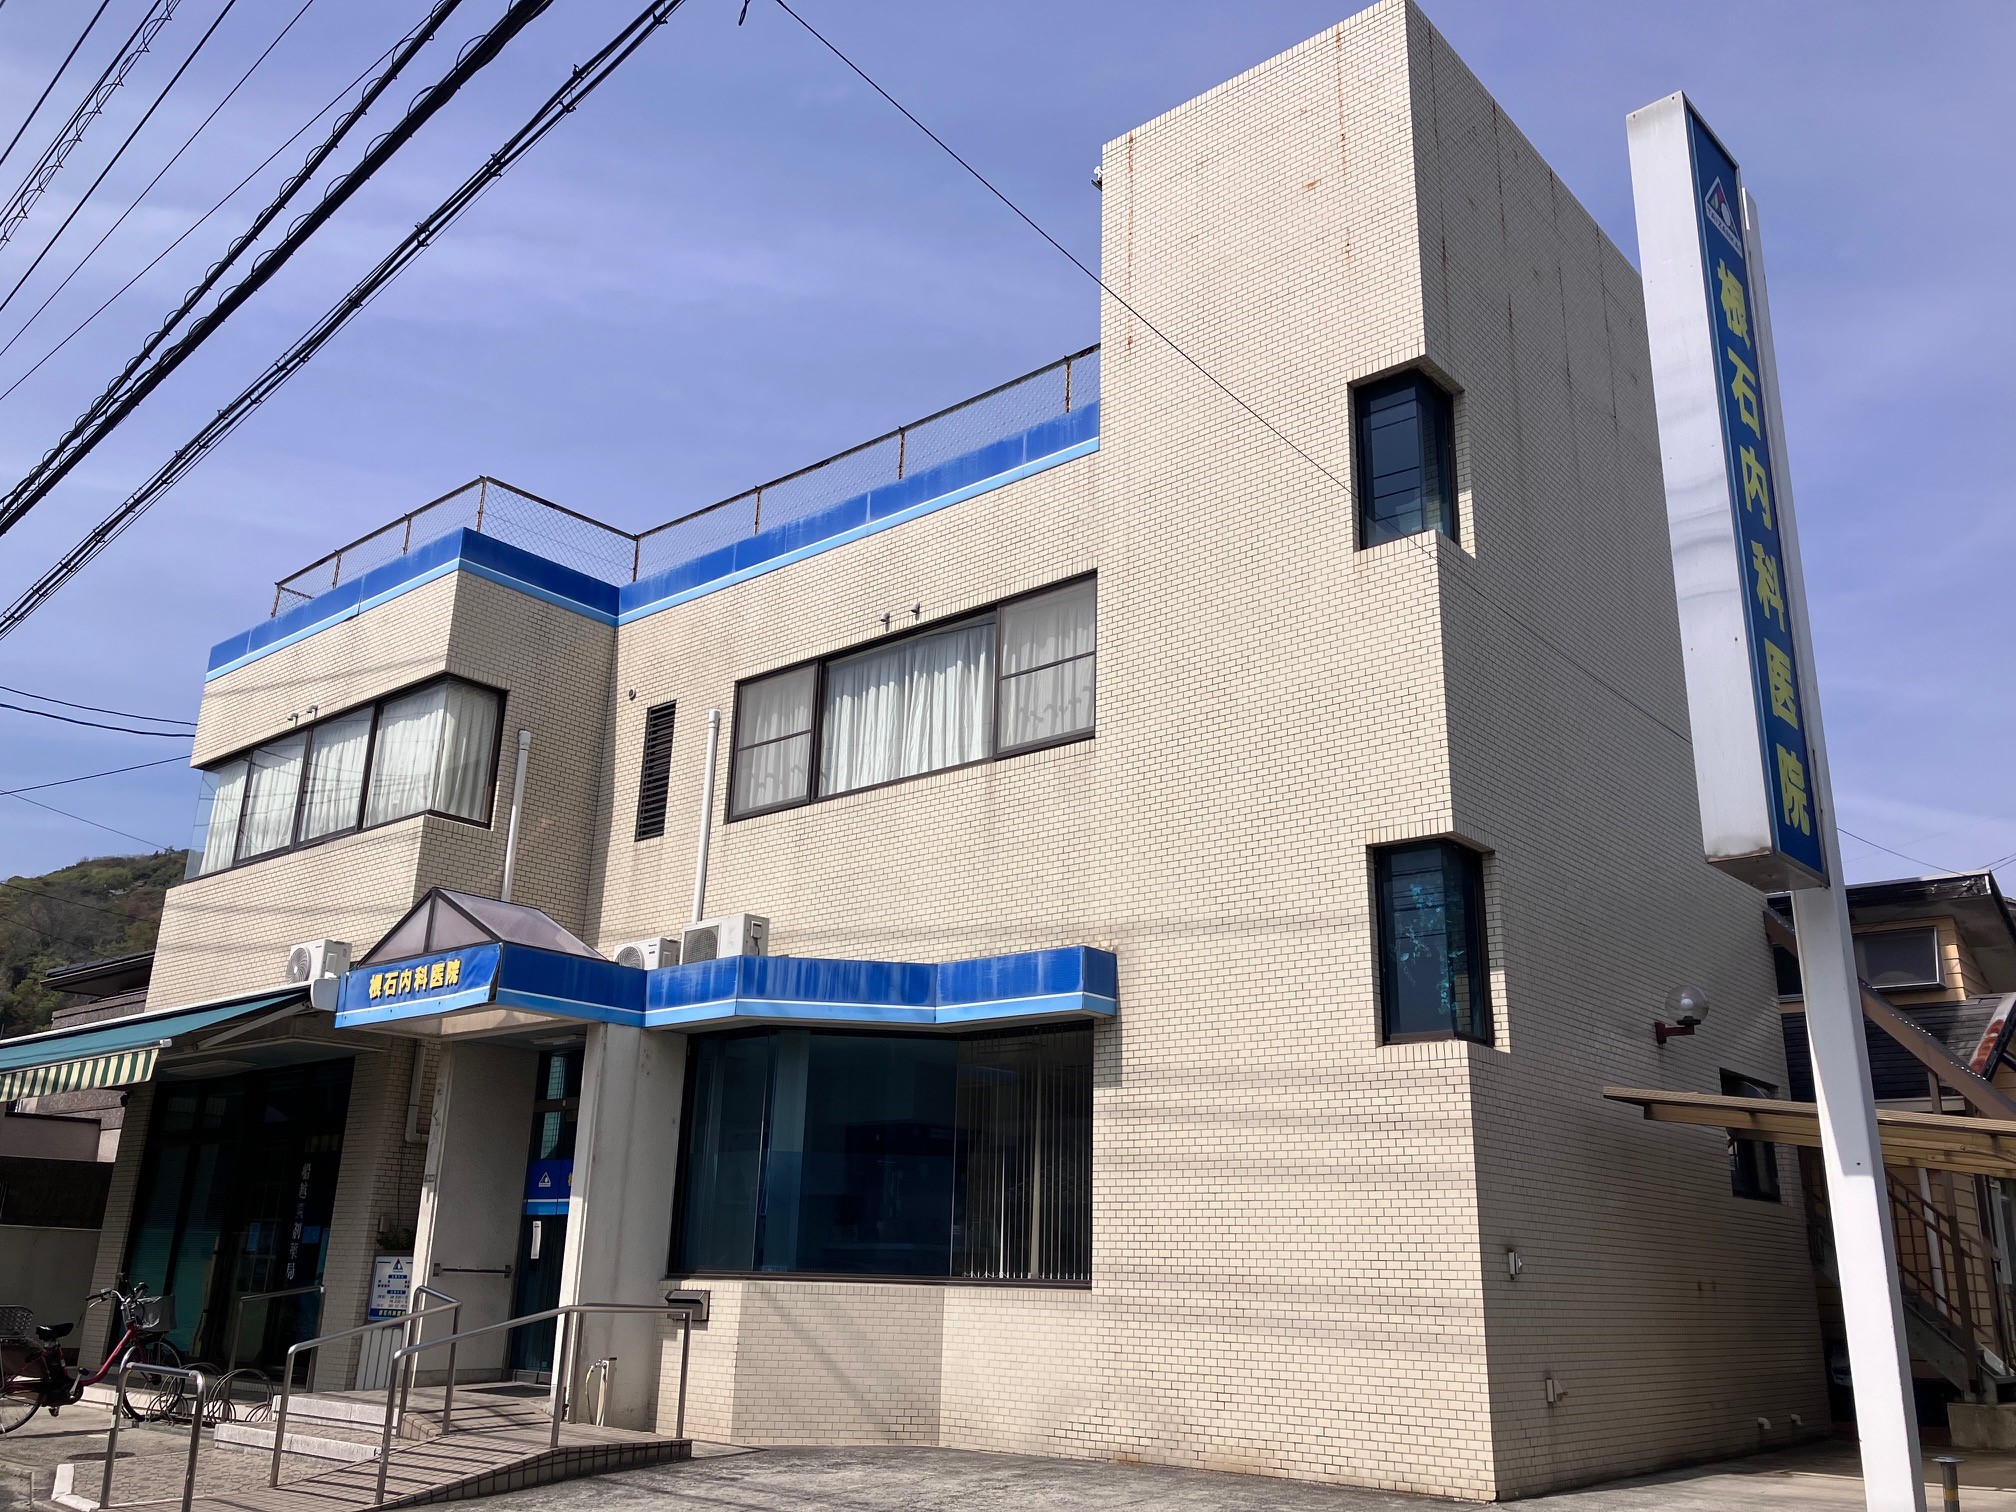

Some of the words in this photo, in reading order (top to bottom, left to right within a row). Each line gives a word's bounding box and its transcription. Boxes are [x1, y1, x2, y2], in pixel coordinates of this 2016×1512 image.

[1717, 257, 1811, 836] 根石内科医院
[369, 959, 461, 1000] 根石内科医院
